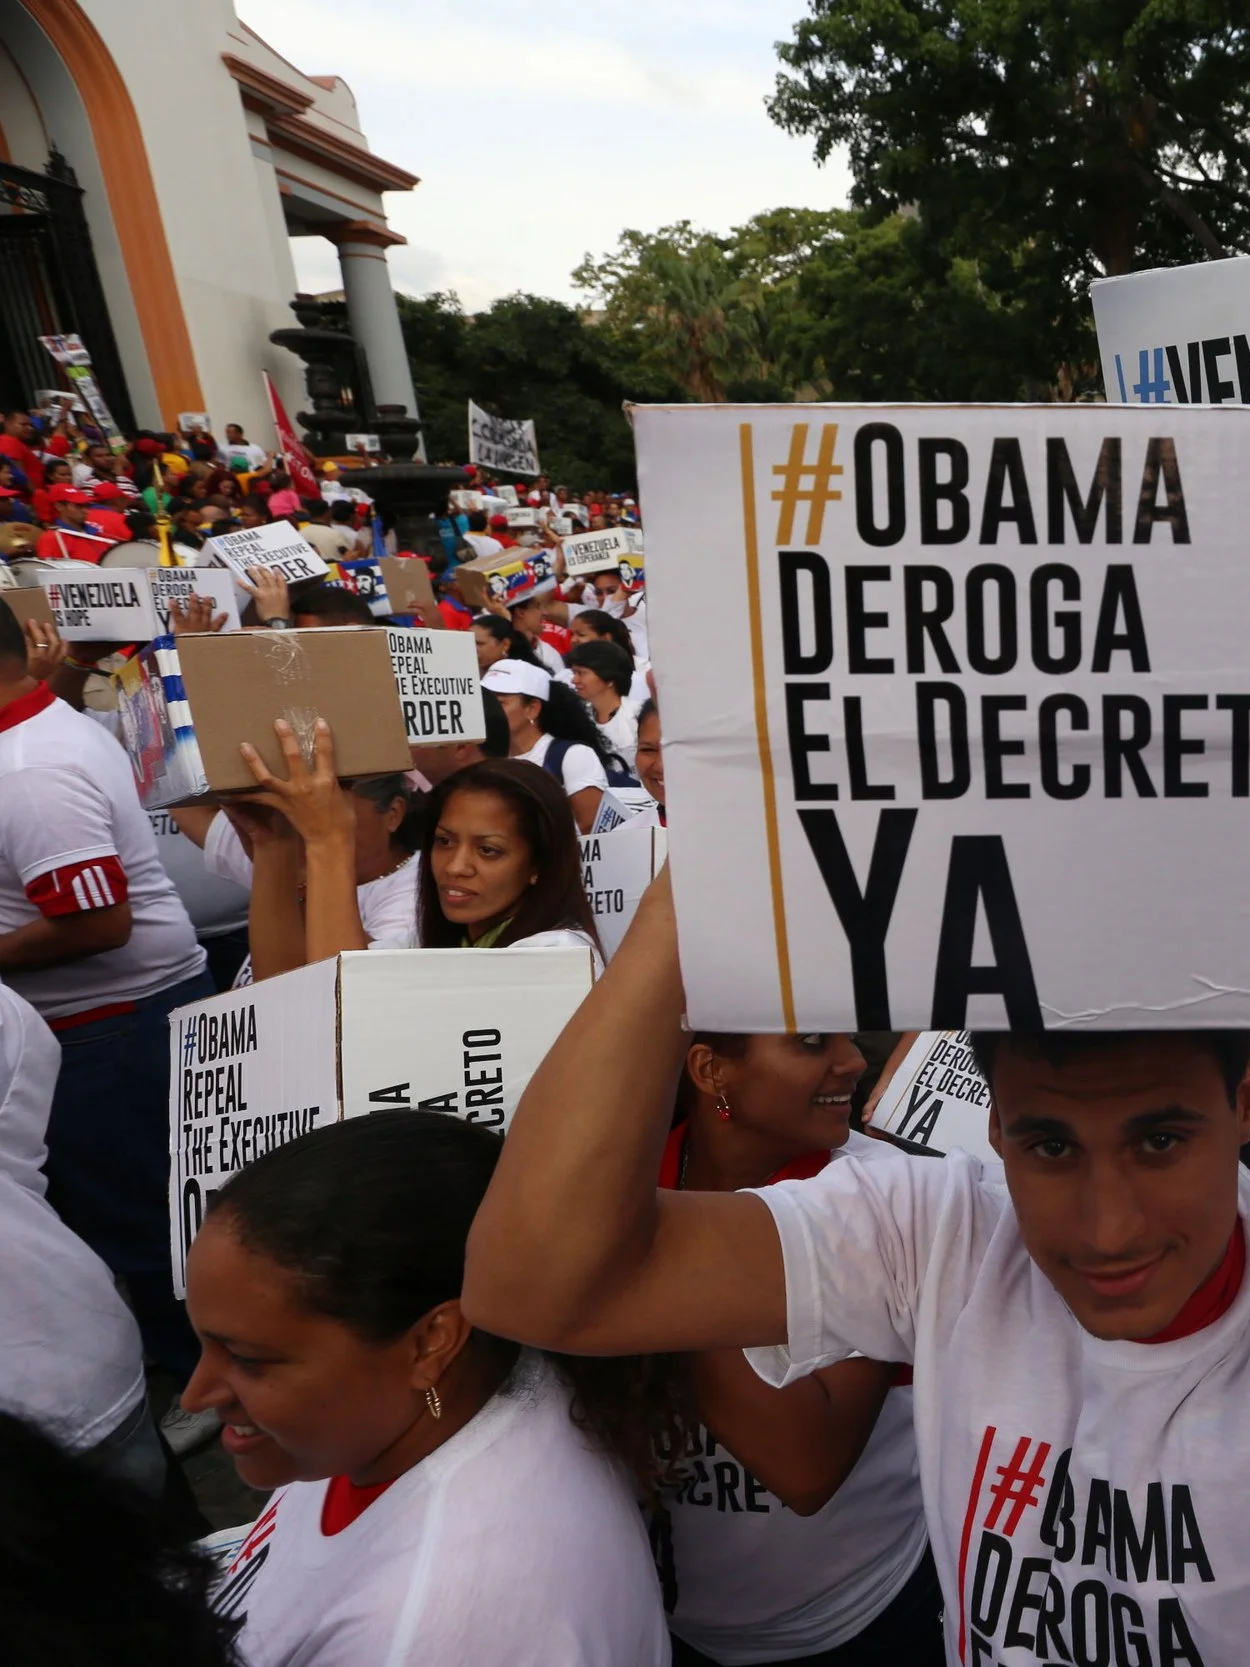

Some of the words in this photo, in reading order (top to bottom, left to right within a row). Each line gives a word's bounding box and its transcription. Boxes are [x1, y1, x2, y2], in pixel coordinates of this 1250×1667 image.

[770, 422, 1192, 547] #OBAMA
[223, 542, 266, 558] REPEAL
[235, 555, 255, 569] THE
[254, 543, 310, 564] EXECUTIVE
[566, 536, 620, 558] #VENEZUELA
[150, 569, 198, 582] #OBAMA
[151, 582, 195, 596] DEROGA
[49, 582, 141, 609] #VENEZUELA
[777, 551, 1151, 676] DEROGA
[66, 609, 92, 627] HOPE
[391, 656, 428, 675] EPEAL
[412, 675, 475, 696] EXECUTIVE
[403, 700, 465, 737] RDER
[785, 682, 897, 802] EL
[796, 808, 1046, 1032] YA
[184, 1004, 257, 1068] #OBAMA
[183, 1062, 248, 1122] REPEAL
[463, 1028, 505, 1130] CRETO
[916, 1061, 938, 1088] EL
[895, 1084, 944, 1146] YA
[183, 1124, 214, 1177] THE
[970, 1530, 1205, 1667] DEROGA
